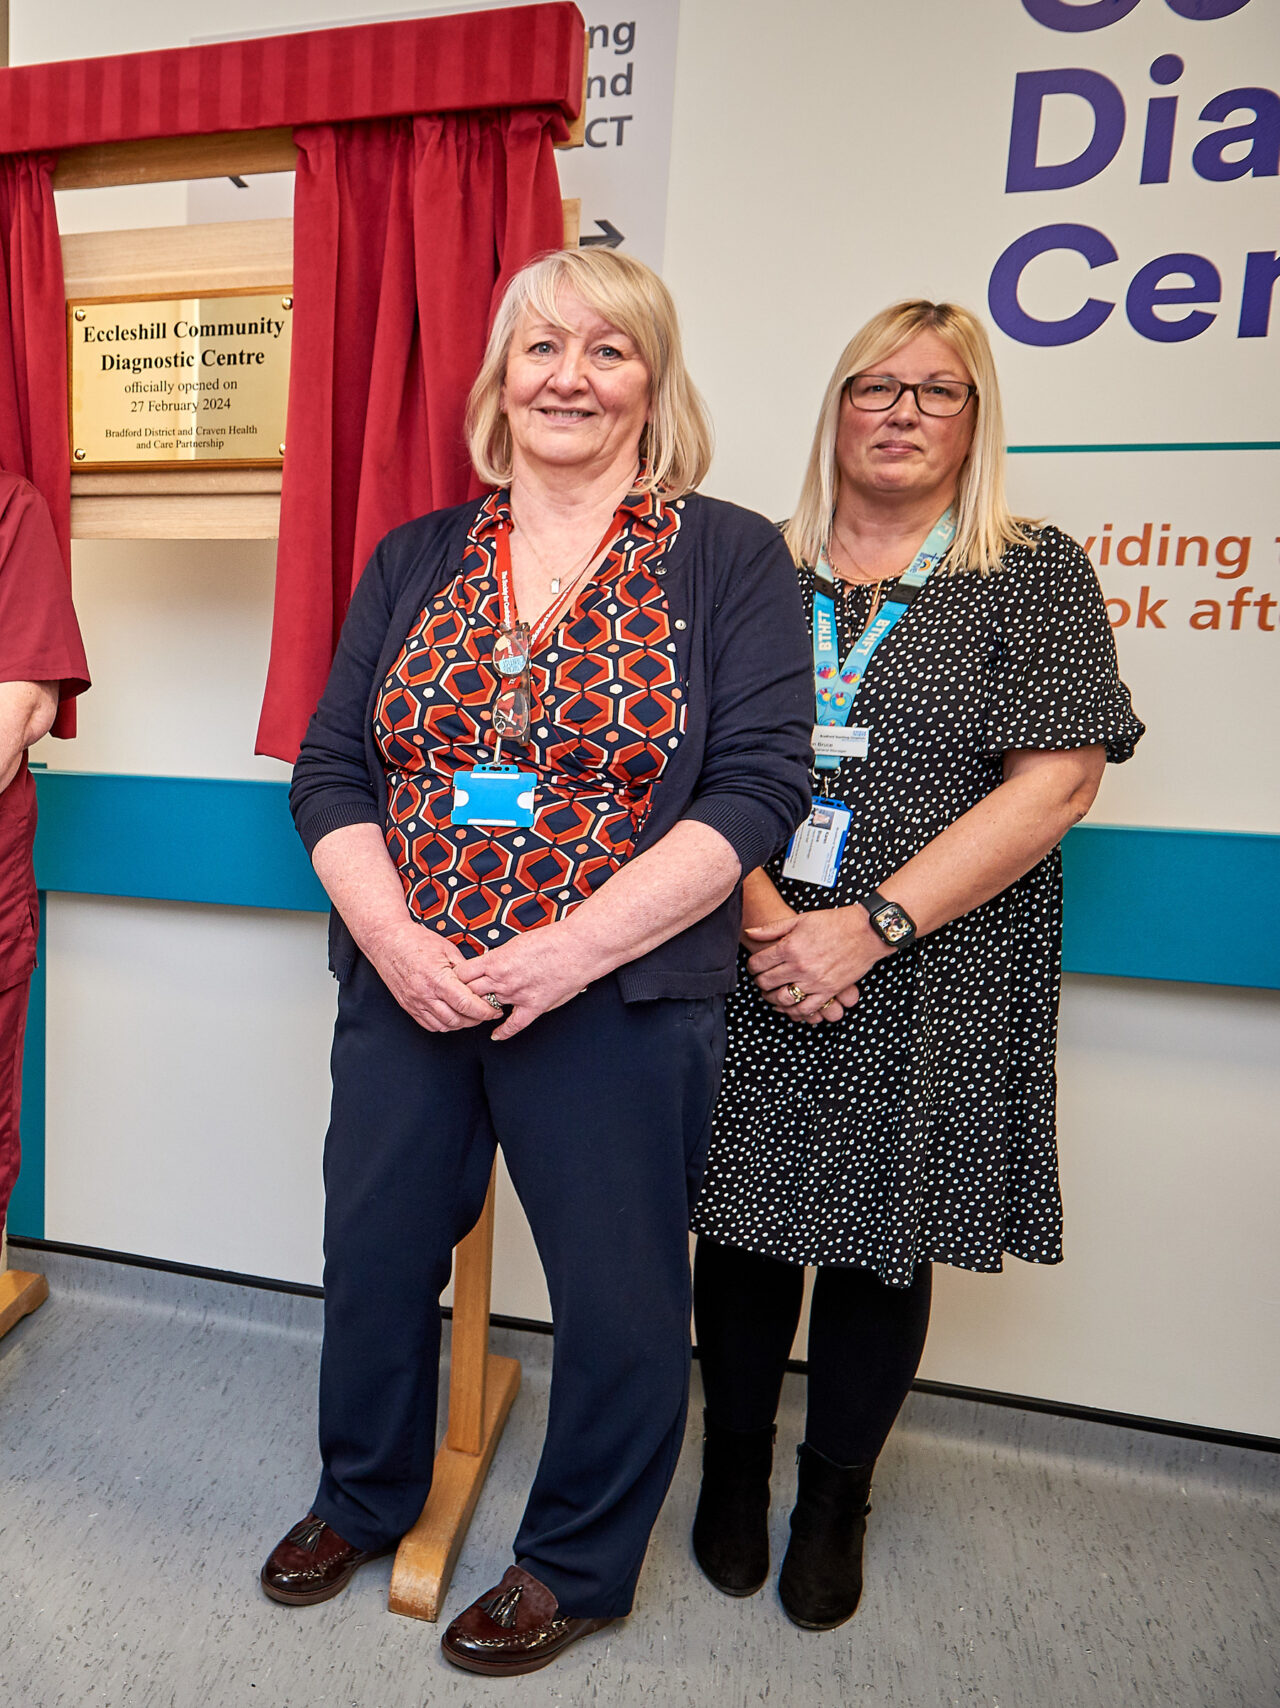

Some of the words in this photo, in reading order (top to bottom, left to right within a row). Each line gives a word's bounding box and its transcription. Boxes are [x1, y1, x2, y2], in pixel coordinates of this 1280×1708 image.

[584, 115, 633, 148] CT
[83, 322, 167, 343] Eccleshill
[173, 316, 285, 338] Community
[101, 351, 195, 374] Diagnostic
[201, 349, 265, 367] Centre
[124, 380, 174, 395] officially
[178, 378, 219, 394] opened
[223, 380, 238, 390] on
[130, 401, 144, 413] 27
[148, 399, 197, 413] February
[202, 398, 231, 410] 2024
[105, 426, 142, 438] Bradford
[144, 427, 175, 437] District
[177, 426, 193, 436] and
[195, 426, 226, 436] Craven
[228, 424, 258, 435] Health
[136, 440, 151, 449] and
[153, 439, 174, 449] Care
[176, 438, 224, 450] Partnership
[1189, 586, 1280, 632] aft
[817, 609, 832, 651] BTHFT
[856, 618, 891, 656] BTHFT
